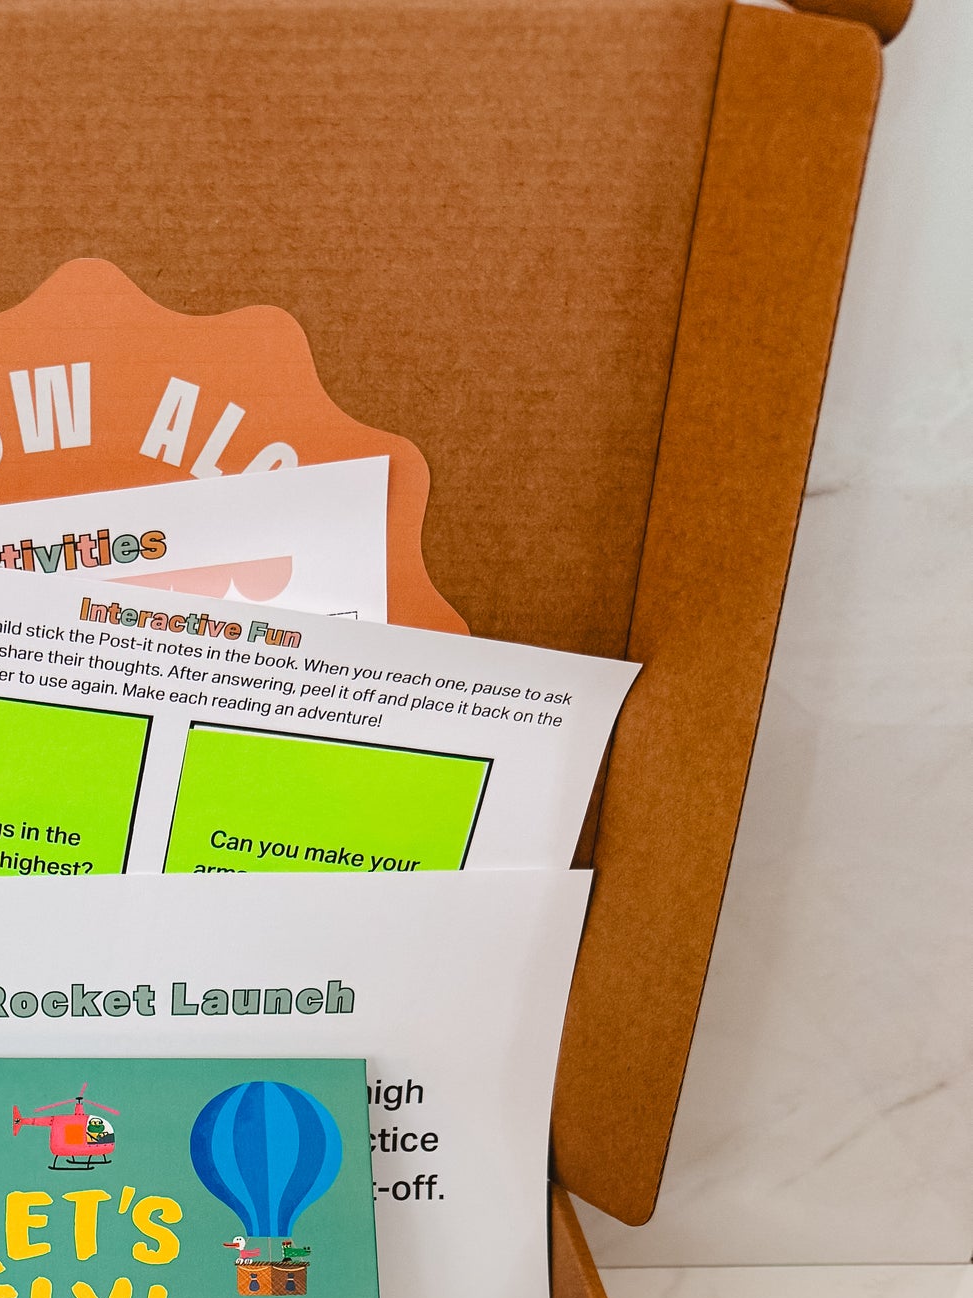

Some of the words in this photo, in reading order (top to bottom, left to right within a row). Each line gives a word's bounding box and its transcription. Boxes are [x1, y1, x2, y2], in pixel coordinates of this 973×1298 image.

[79, 597, 243, 642] Interactive
[247, 620, 303, 649] Fun
[25, 624, 66, 642] stick
[68, 628, 96, 645] the
[98, 631, 155, 653] Post-it
[155, 642, 204, 659] notes
[224, 648, 252, 665] the
[253, 651, 299, 671] book.
[304, 657, 350, 677] When
[350, 667, 384, 681] you
[384, 671, 432, 687] reach
[434, 677, 469, 694] one,
[470, 682, 522, 699] pause
[543, 691, 573, 706] ask
[47, 649, 86, 668] their
[87, 654, 164, 678] thoughts.
[166, 664, 210, 683] After
[210, 672, 297, 697] answering,
[299, 683, 337, 699] peel
[351, 687, 378, 704] off
[376, 692, 410, 708] and
[409, 695, 455, 714] place
[470, 701, 511, 721] back
[512, 710, 534, 724] on
[536, 711, 563, 728] the
[38, 674, 69, 690] use
[70, 679, 119, 696] again.
[121, 681, 166, 702] Make
[168, 690, 209, 707] each
[210, 695, 272, 718] reading
[296, 705, 384, 729] adventure!
[20, 821, 41, 842] in
[45, 825, 82, 847] the
[210, 829, 254, 854] Can
[256, 840, 300, 860] you
[303, 846, 365, 868] make
[367, 855, 422, 873] your
[0, 850, 94, 877] highest?
[170, 980, 356, 1017] Launch
